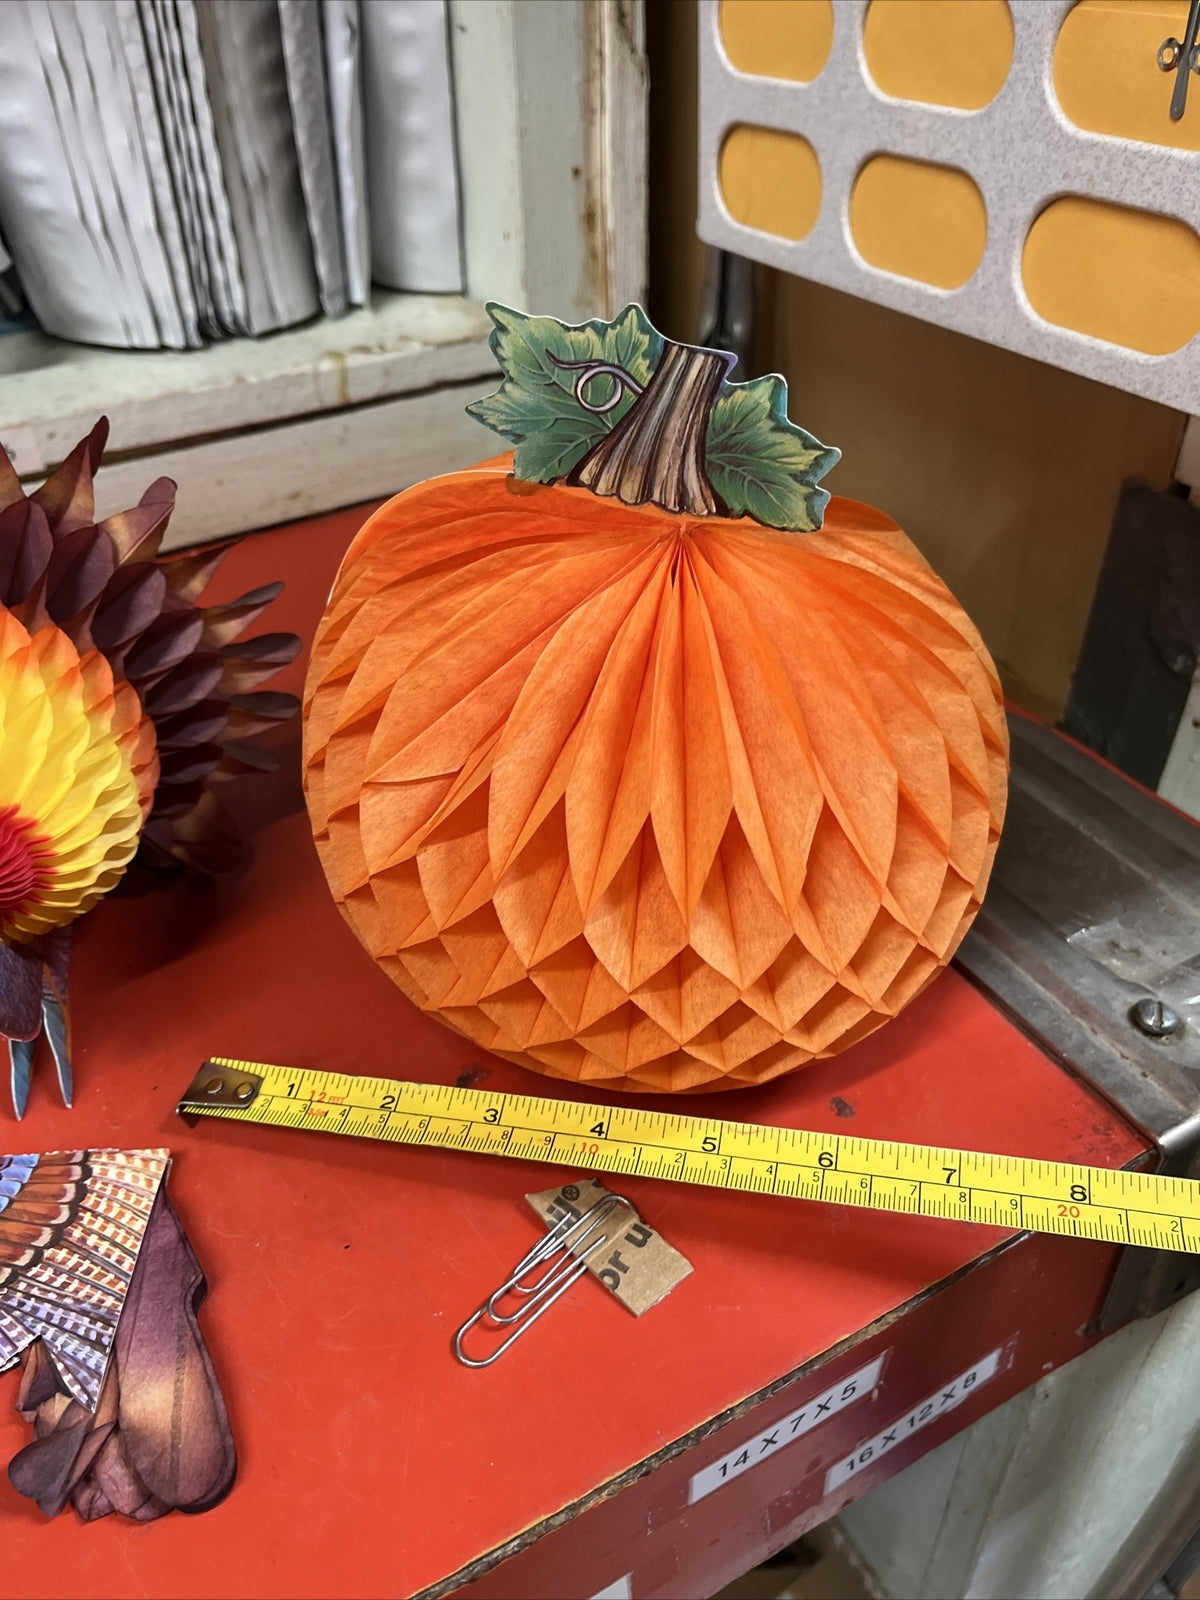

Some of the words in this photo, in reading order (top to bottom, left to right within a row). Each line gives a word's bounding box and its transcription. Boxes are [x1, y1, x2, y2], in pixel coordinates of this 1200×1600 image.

[261, 1099, 270, 1108] 2
[299, 1104, 307, 1113] 3
[339, 1109, 347, 1118] 4
[377, 1114, 386, 1123] 5
[419, 1119, 427, 1129] 6
[460, 1125, 469, 1134] 7
[501, 1130, 509, 1140] 8
[543, 1136, 552, 1146] 9
[581, 1142, 599, 1155] 10
[675, 1153, 683, 1163] 2
[720, 1159, 727, 1169] 3
[765, 1165, 774, 1175] 4
[812, 1172, 820, 1182] 5
[860, 1178, 868, 1188] 6
[909, 1185, 917, 1195] 7
[959, 1192, 967, 1202] 8
[1010, 1199, 1018, 1210] 9
[1057, 1205, 1080, 1218] 20
[1117, 1214, 1123, 1225] 1
[1170, 1221, 1179, 1232] 2
[287, 1083, 295, 1096] 1
[380, 1096, 395, 1109] 2
[483, 1109, 498, 1122] 3
[590, 1122, 605, 1136] 4
[701, 1137, 717, 1152] 5
[818, 1152, 834, 1167] 6
[942, 1168, 957, 1184] 7
[1070, 1185, 1087, 1201] 8
[718, 1450, 750, 1477] 14
[790, 1415, 806, 1432] 7
[840, 1380, 857, 1399] 5
[847, 1450, 873, 1471] 16
[907, 1404, 933, 1428] 12
[963, 1372, 977, 1389] 8
